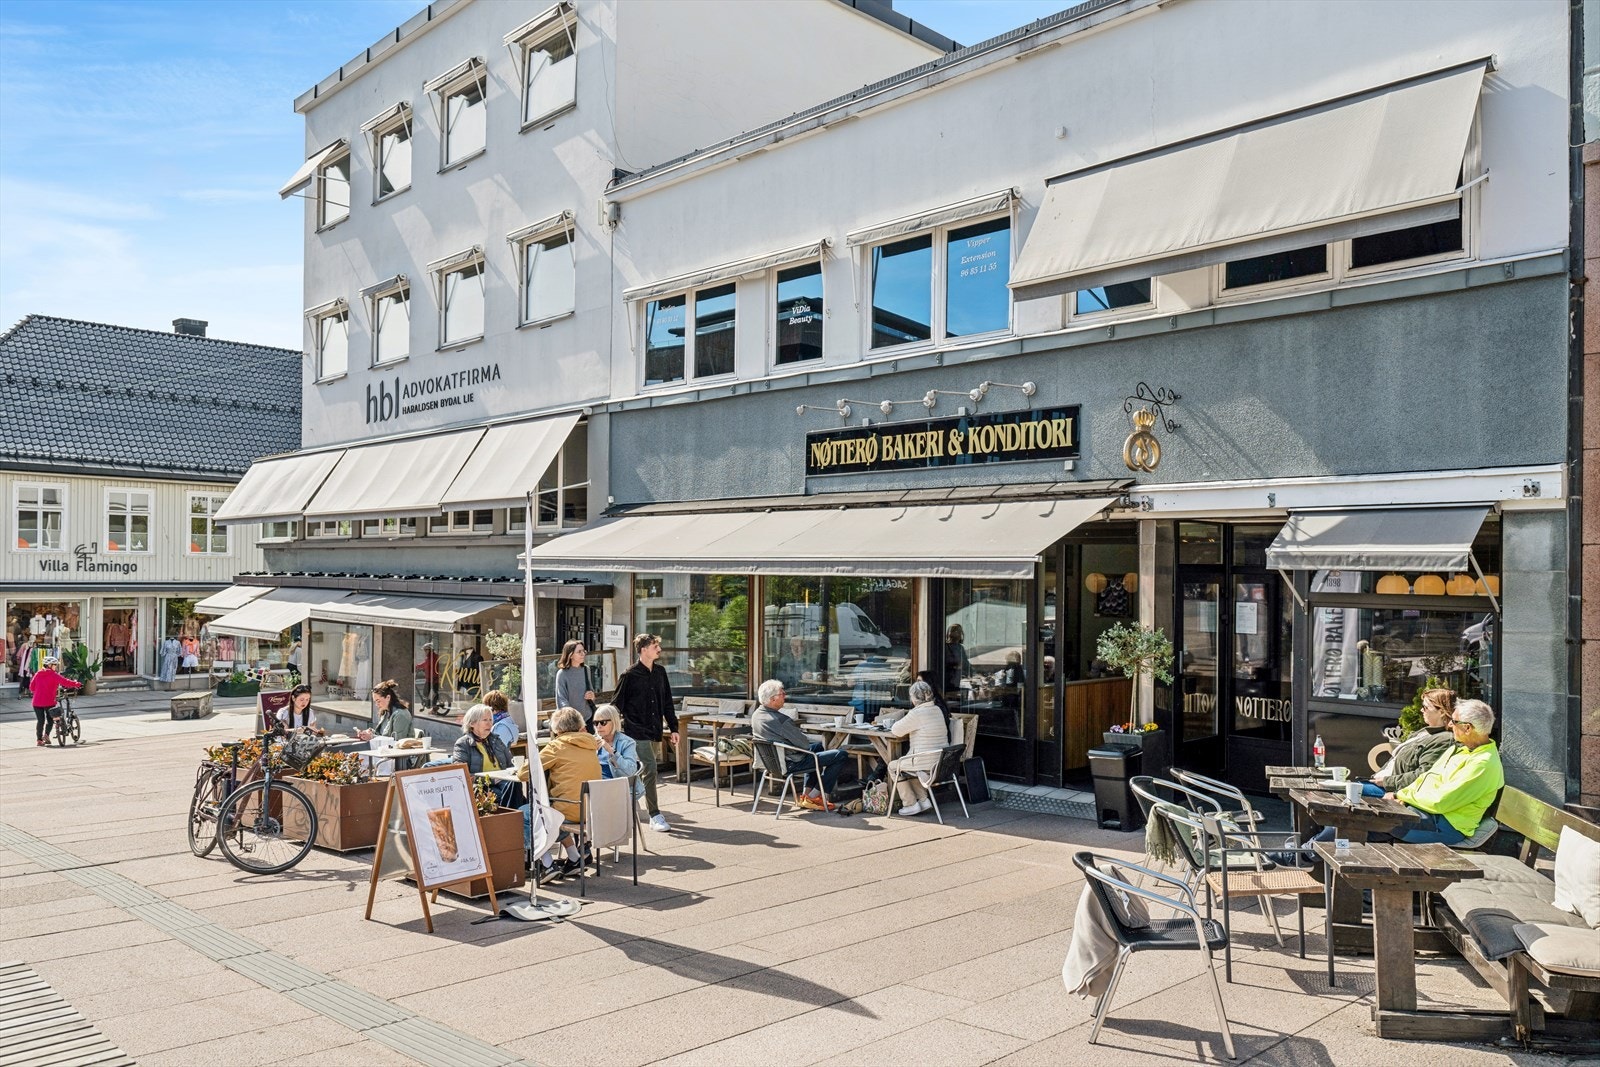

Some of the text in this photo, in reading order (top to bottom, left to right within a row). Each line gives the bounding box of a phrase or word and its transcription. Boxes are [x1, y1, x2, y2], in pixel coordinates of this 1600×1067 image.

[961, 250, 996, 264] Extension
[960, 269, 969, 277] 96
[789, 315, 813, 325] Beauty
[402, 363, 501, 399] ADVOKATFIRMA
[402, 393, 474, 415] HARALDSEN BYDAL LIE
[810, 418, 1073, 469] NØTTERØ BAKERI & KONDITORI
[39, 559, 138, 575] Villa Flamingo
[1326, 578, 1341, 588] 1898
